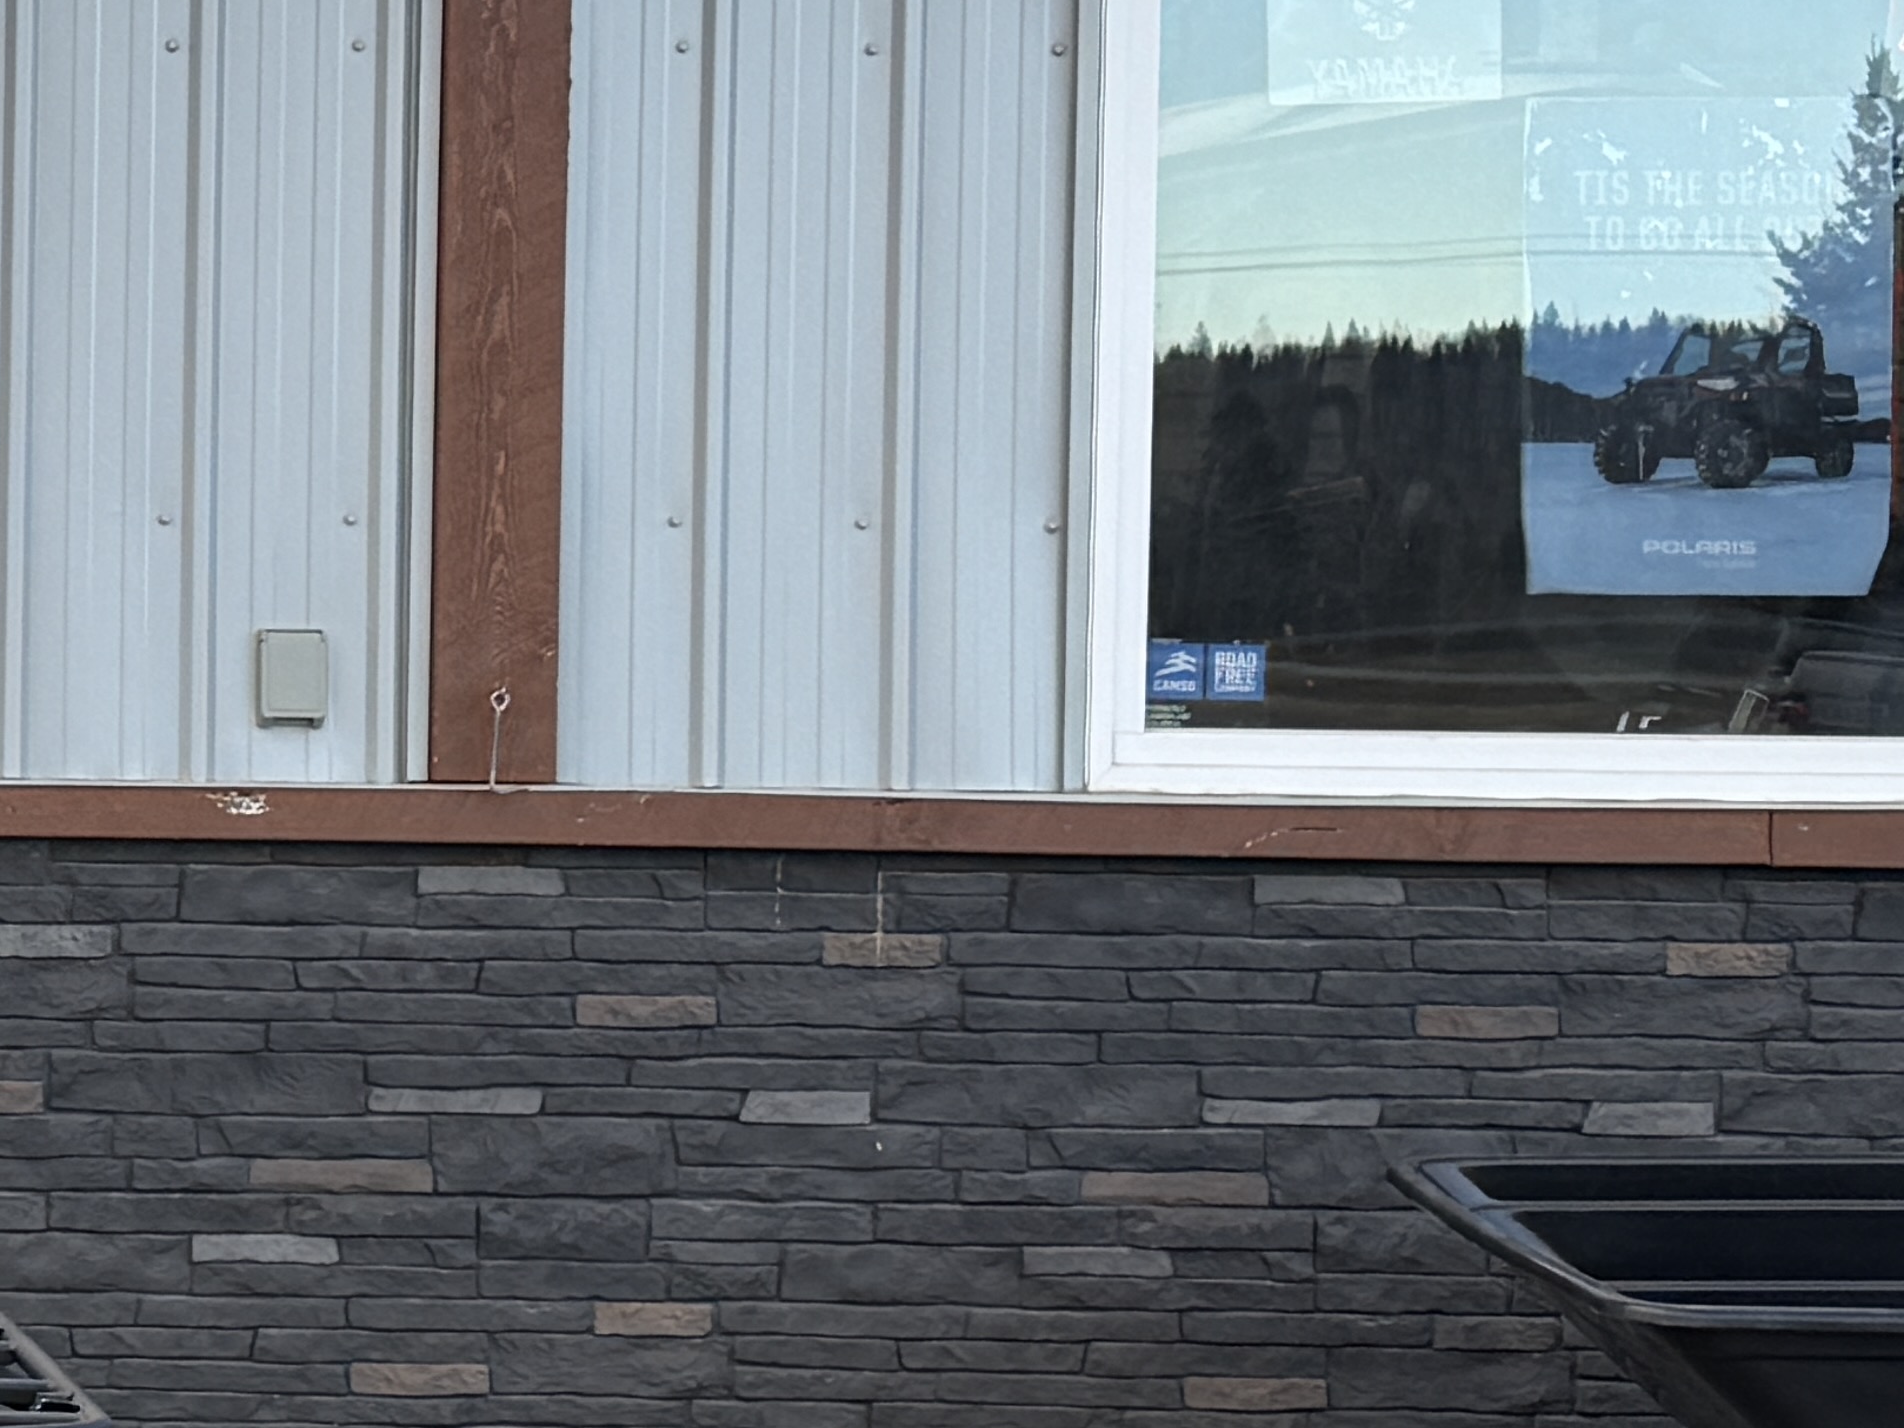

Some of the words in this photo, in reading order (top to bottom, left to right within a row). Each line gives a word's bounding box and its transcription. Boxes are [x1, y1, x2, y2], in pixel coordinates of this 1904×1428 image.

[1646, 169, 1704, 206] THE
[1585, 216, 1625, 250] TO
[1642, 539, 1757, 555] POLARIS
